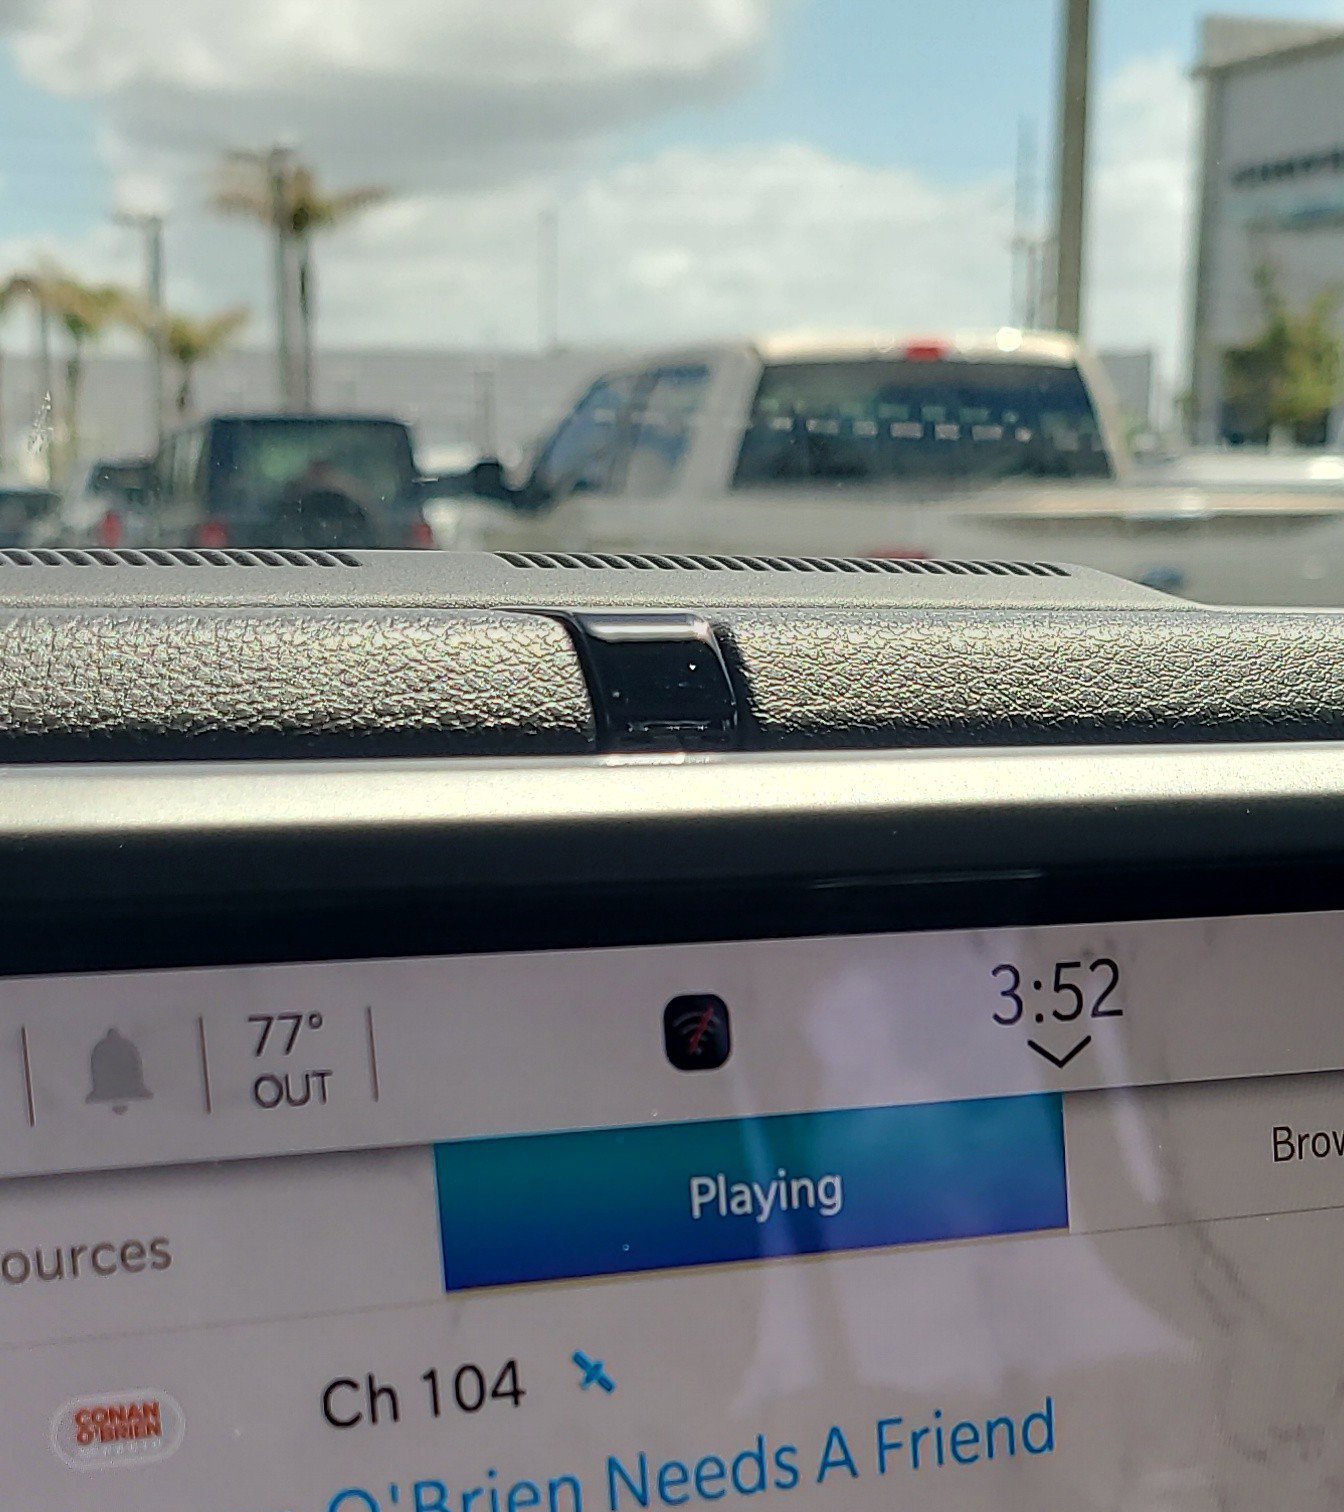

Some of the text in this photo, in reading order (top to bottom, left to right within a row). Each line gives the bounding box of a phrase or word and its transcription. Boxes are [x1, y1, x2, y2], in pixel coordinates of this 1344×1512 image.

[990, 958, 1125, 1026] 3:52
[248, 1011, 324, 1056] 77°
[254, 1069, 333, 1109] OUT
[689, 1168, 844, 1220] Playing
[74, 1401, 161, 1425] CONAN
[321, 1358, 526, 1430] Ch 104
[76, 1417, 162, 1446] O'BRIEN
[606, 1434, 800, 1512] Needs
[815, 1426, 860, 1485] A
[876, 1396, 1056, 1475] Friend
